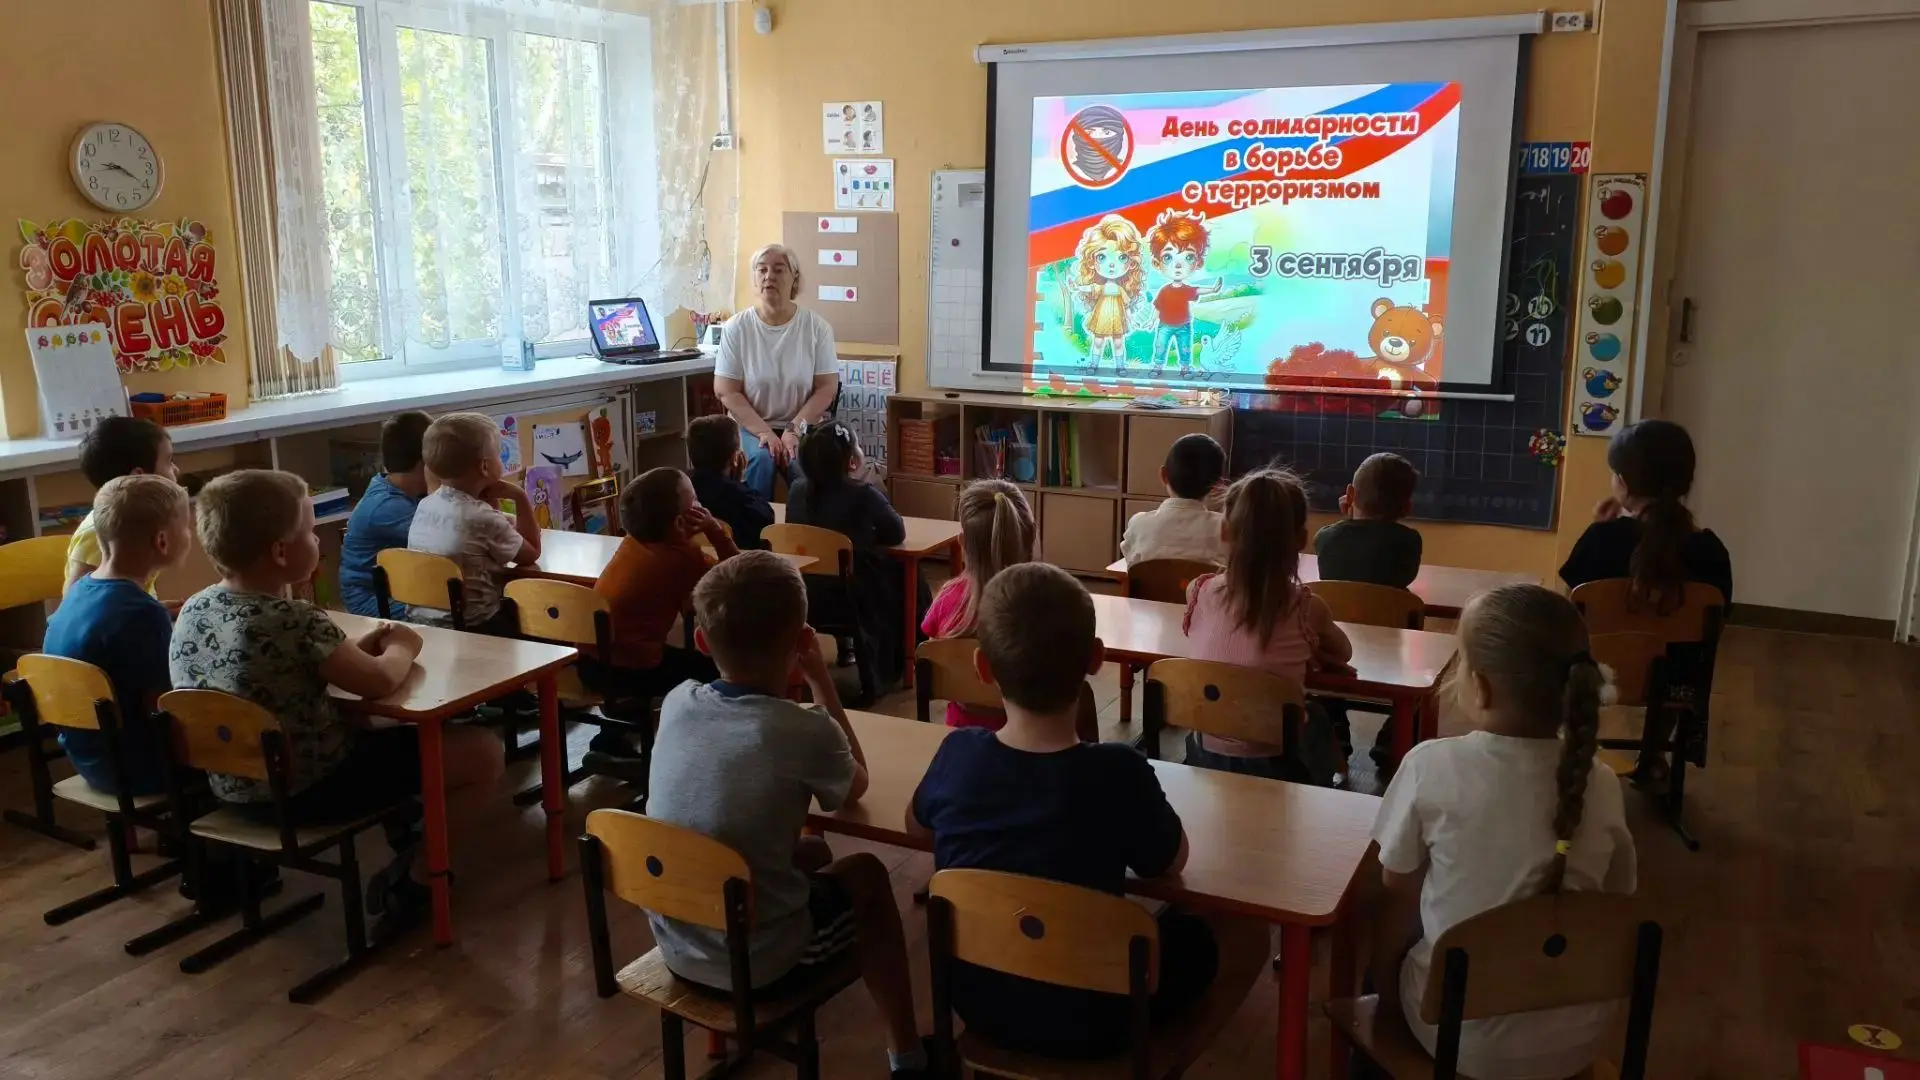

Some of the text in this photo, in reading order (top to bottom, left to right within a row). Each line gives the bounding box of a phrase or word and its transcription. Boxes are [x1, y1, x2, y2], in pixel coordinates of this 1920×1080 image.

[1161, 114, 1417, 141] День солидарности
[97, 131, 103, 145] 11
[109, 129, 120, 142] 12
[84, 143, 96, 156] 10
[138, 147, 146, 159] 2
[1225, 143, 1340, 173] в борьбе
[1531, 147, 1550, 168] 18
[1552, 147, 1570, 168] 19
[1571, 147, 1589, 168] 20
[80, 159, 89, 170] 9
[145, 162, 153, 175] 3
[89, 176, 98, 189] 8
[141, 179, 150, 190] 4
[102, 187, 109, 200] 7
[117, 192, 127, 207] 6
[133, 188, 141, 200] 5
[1184, 181, 1381, 206] с терроризмом
[20, 231, 216, 291] ЗОЛОТАЯ
[1250, 247, 1419, 286] 3 сентября
[850, 369, 892, 386] Д Е Ё
[851, 393, 860, 408] К
[865, 394, 876, 408] Л
[866, 419, 876, 432] Т
